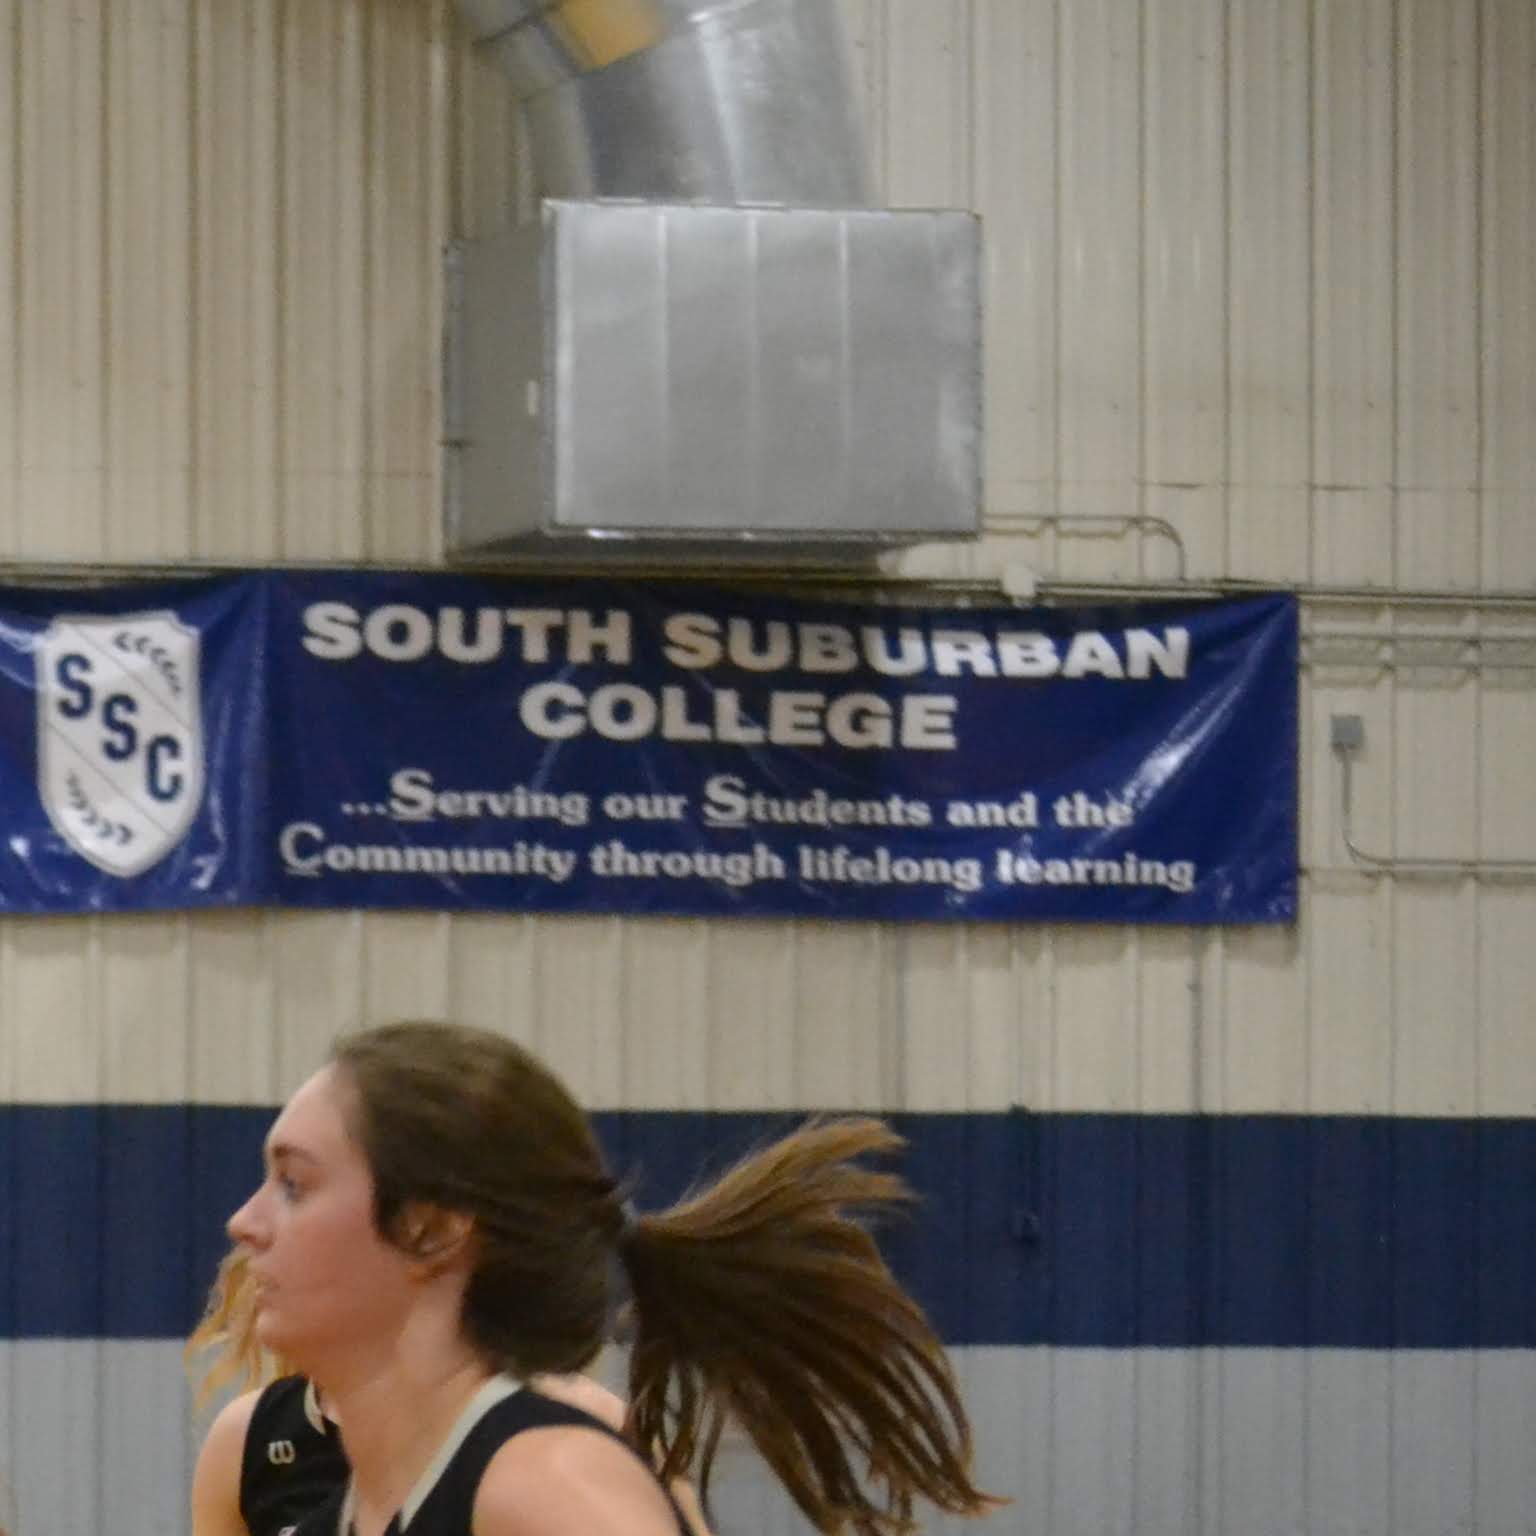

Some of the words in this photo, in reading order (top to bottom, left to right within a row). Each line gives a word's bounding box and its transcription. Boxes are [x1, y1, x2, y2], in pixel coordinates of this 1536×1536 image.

[302, 601, 634, 664] SOUTH
[663, 611, 1191, 680] SUBURBAN
[519, 681, 959, 751] COLLEGE
[604, 797, 688, 820] our
[702, 774, 933, 828] Students
[946, 793, 1040, 828] and
[1054, 793, 1135, 828] the
[280, 821, 577, 882] Community
[590, 840, 786, 888] through
[798, 845, 983, 893] lifelong
[996, 848, 1196, 893] learning
